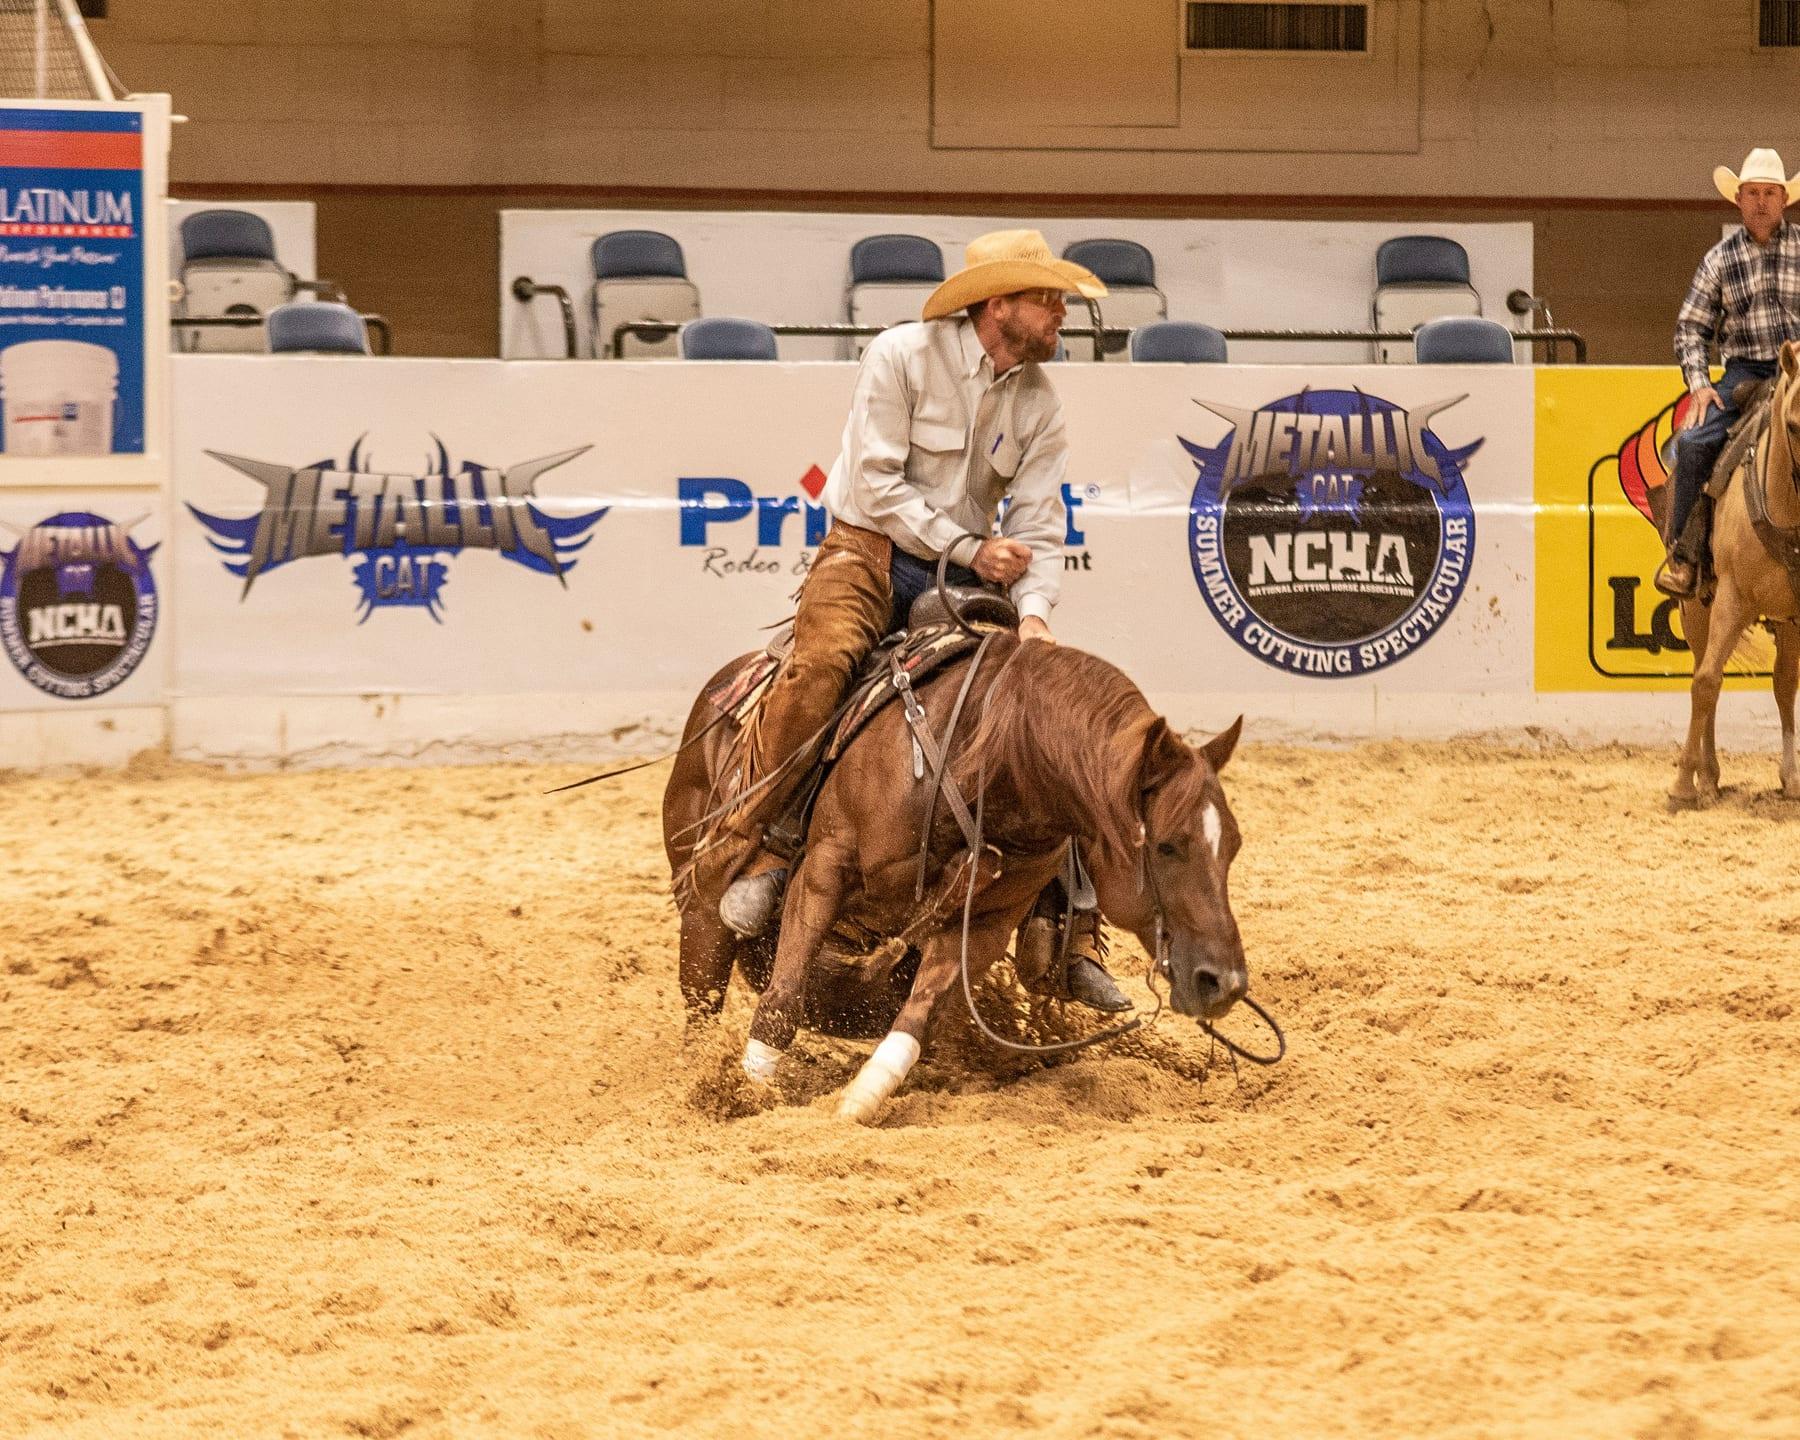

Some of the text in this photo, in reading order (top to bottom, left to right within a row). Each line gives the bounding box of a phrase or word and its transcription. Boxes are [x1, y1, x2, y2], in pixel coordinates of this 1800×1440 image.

[0, 188, 133, 224] LATINUM
[1212, 405, 1450, 495] METALLIC
[677, 464, 1084, 546] Prit
[1312, 475, 1353, 501] CAT
[225, 462, 575, 590] METALLIC
[374, 556, 433, 597] CAT
[702, 547, 811, 578] Rodeo &
[1248, 531, 1414, 586] NCHA
[1196, 515, 1467, 673] SUMMER CUTTING SPECTACULAR
[1248, 582, 1415, 598] NATIONAL CUTTING HORSE ASSOCIATION
[28, 603, 128, 640] NCHA
